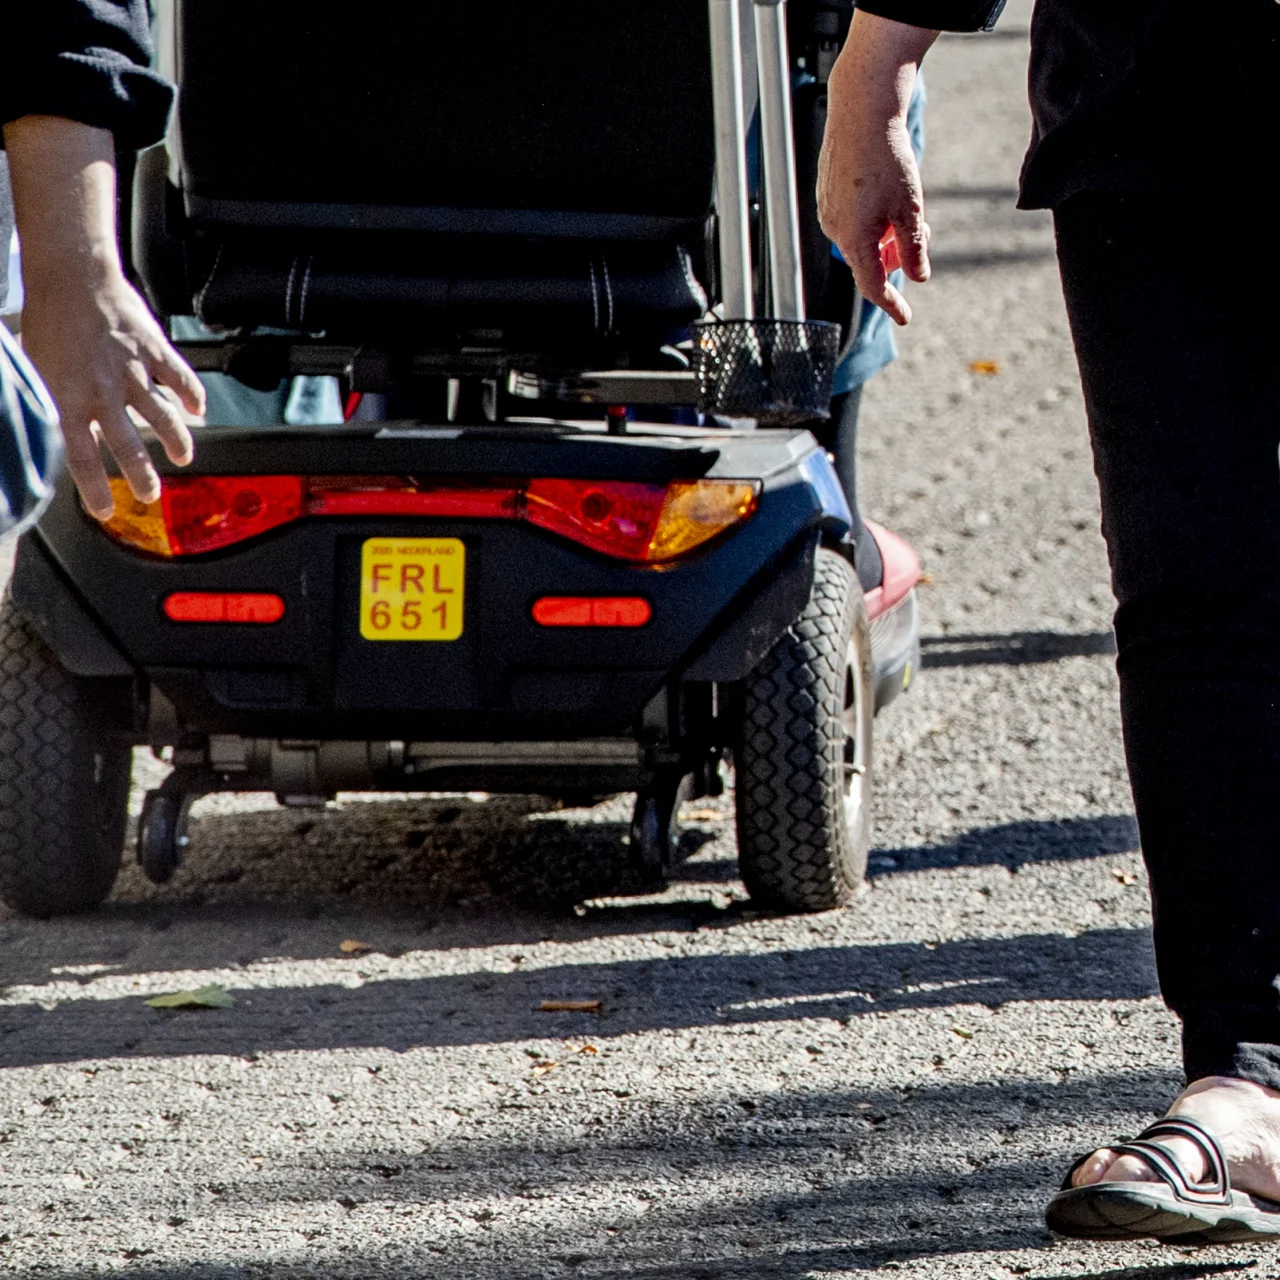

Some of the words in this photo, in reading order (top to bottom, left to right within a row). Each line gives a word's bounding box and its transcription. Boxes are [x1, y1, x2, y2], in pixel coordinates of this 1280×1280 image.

[397, 546, 456, 556] NEDERLAND
[371, 563, 454, 594] FRL
[369, 600, 447, 631] 651
